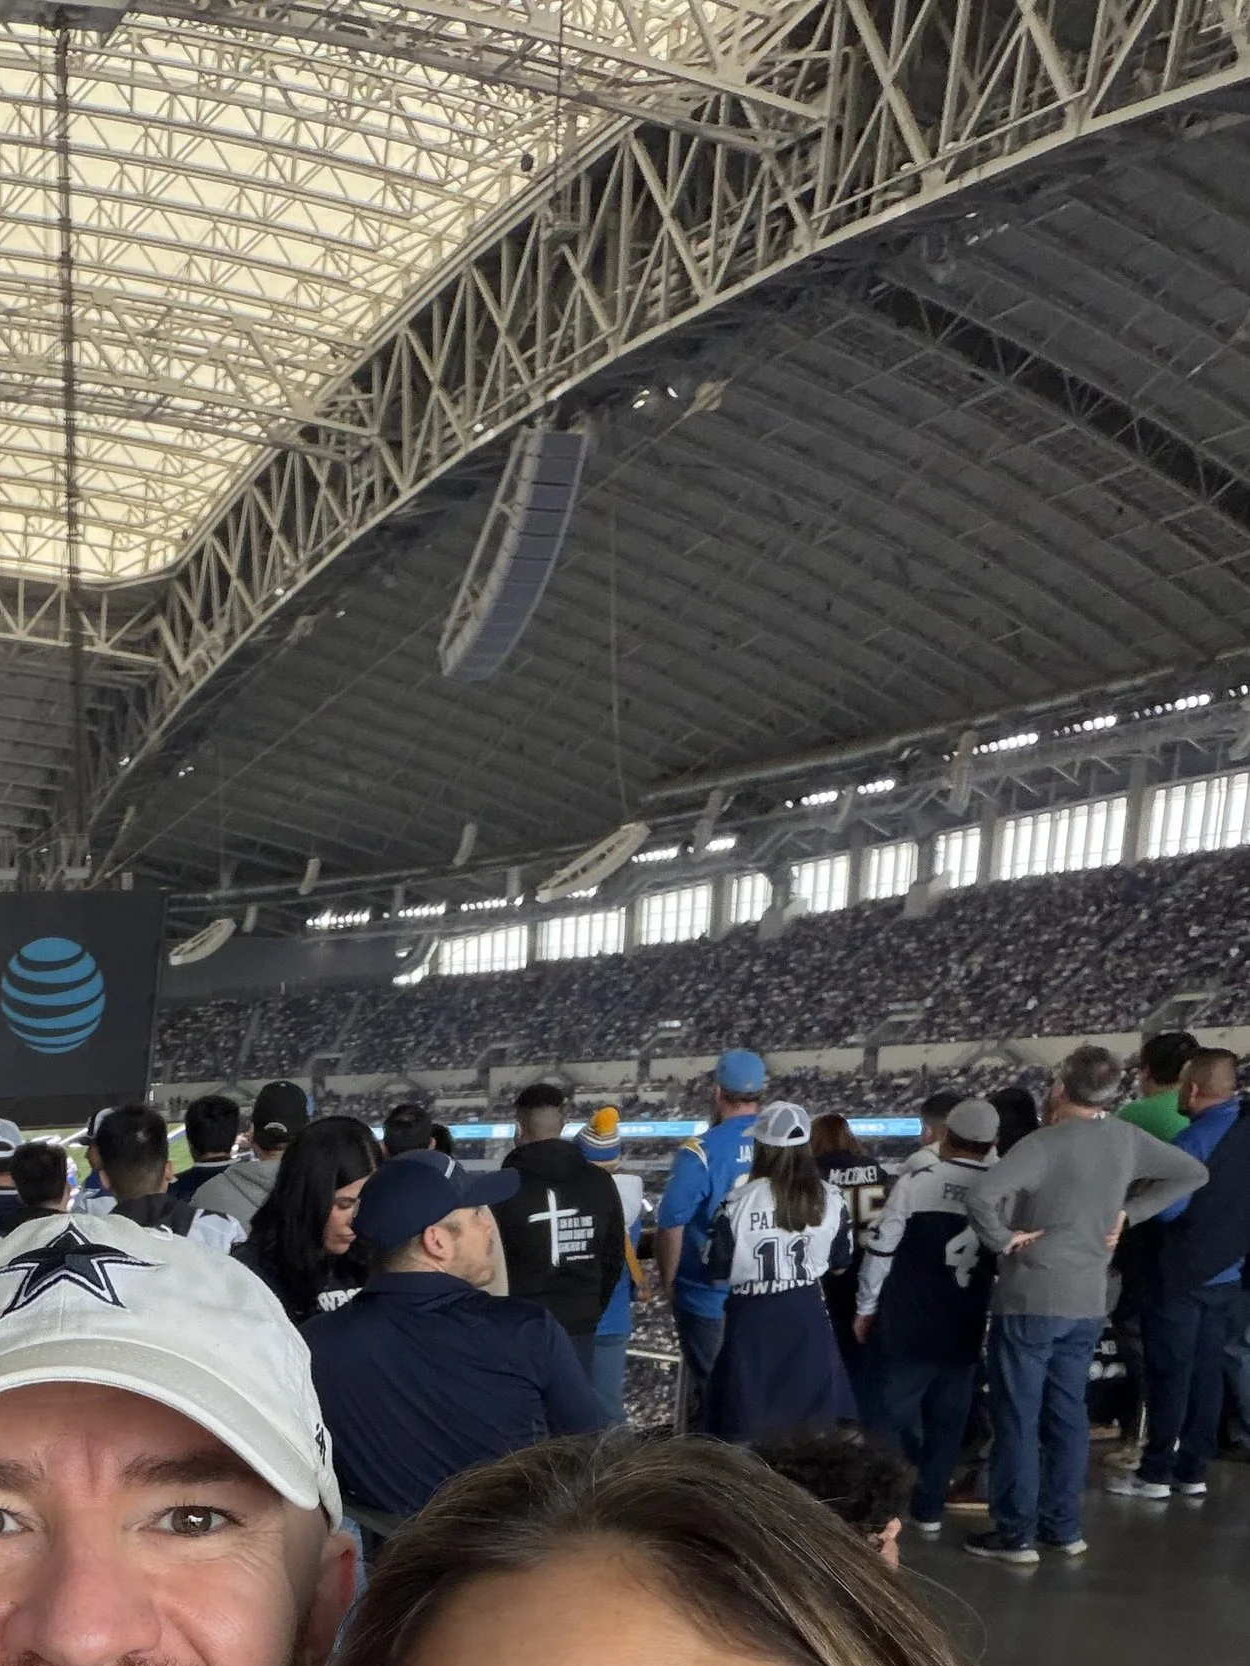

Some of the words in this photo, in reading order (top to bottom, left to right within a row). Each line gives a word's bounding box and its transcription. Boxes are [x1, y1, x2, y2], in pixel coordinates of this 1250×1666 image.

[750, 1211, 776, 1230] PA
[753, 1235, 813, 1281] 11
[945, 1225, 981, 1288] 4
